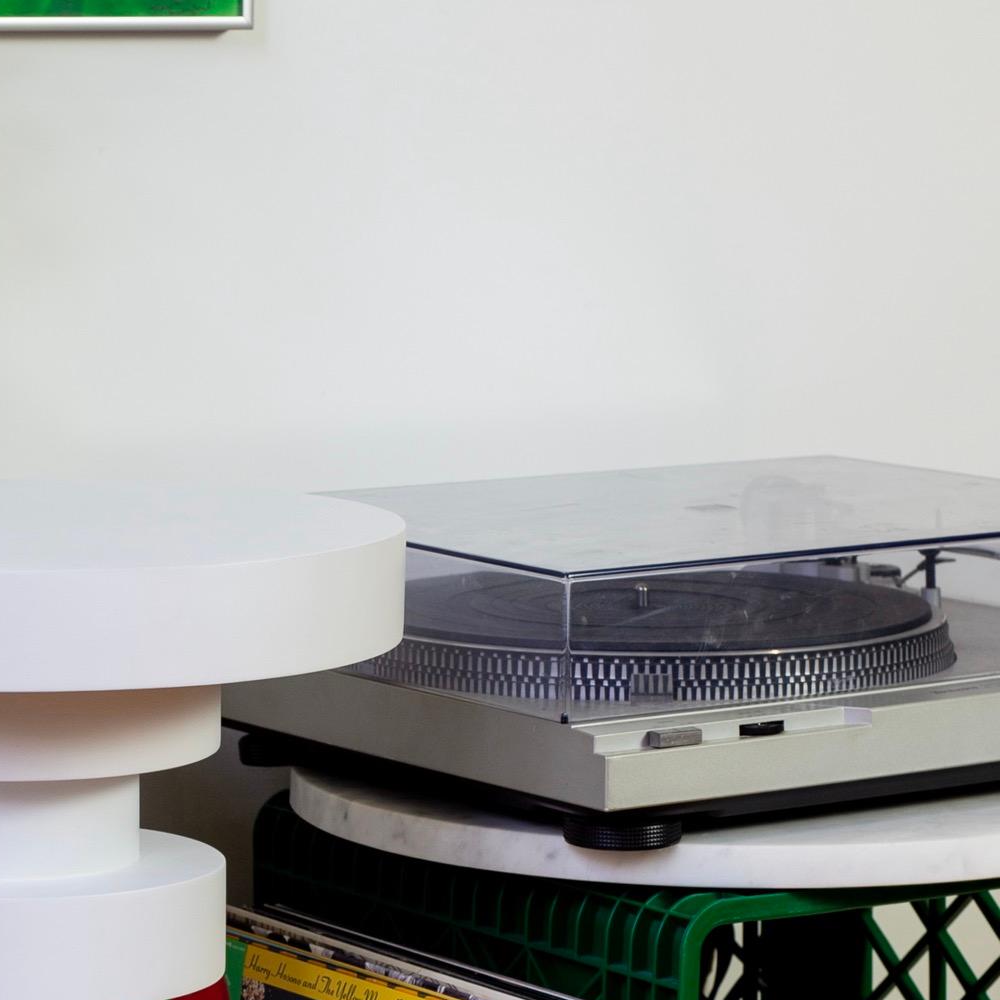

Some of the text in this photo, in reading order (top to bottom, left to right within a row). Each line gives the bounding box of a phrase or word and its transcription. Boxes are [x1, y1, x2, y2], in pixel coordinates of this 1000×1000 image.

[248, 954, 271, 978] Harry
[302, 975, 320, 991] and
[317, 976, 334, 997] The
